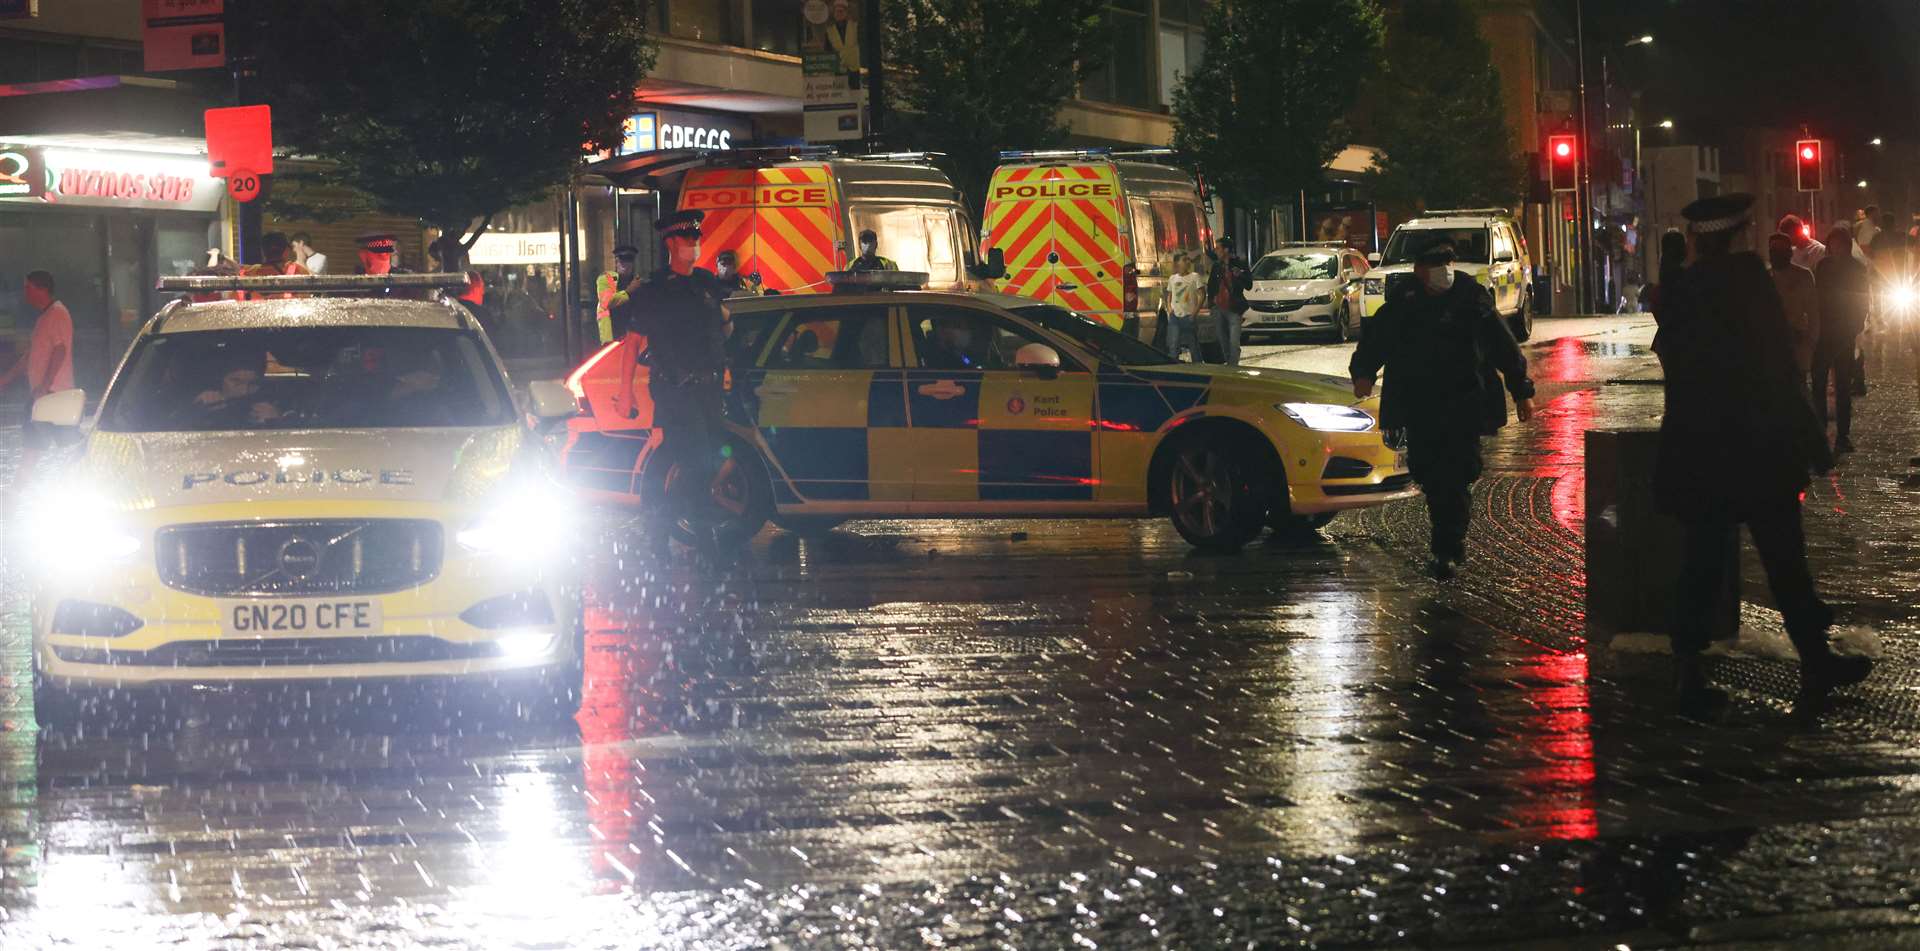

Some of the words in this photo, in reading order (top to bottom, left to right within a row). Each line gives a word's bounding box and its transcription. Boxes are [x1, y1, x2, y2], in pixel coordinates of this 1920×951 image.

[233, 176, 256, 192] 20
[996, 184, 1112, 199] POLICE
[687, 188, 826, 207] POLICE
[1033, 395, 1060, 405] Kent
[1034, 407, 1067, 417] Police
[182, 469, 416, 490] POLICE
[233, 604, 306, 632] GN20
[316, 602, 370, 630] CFE
